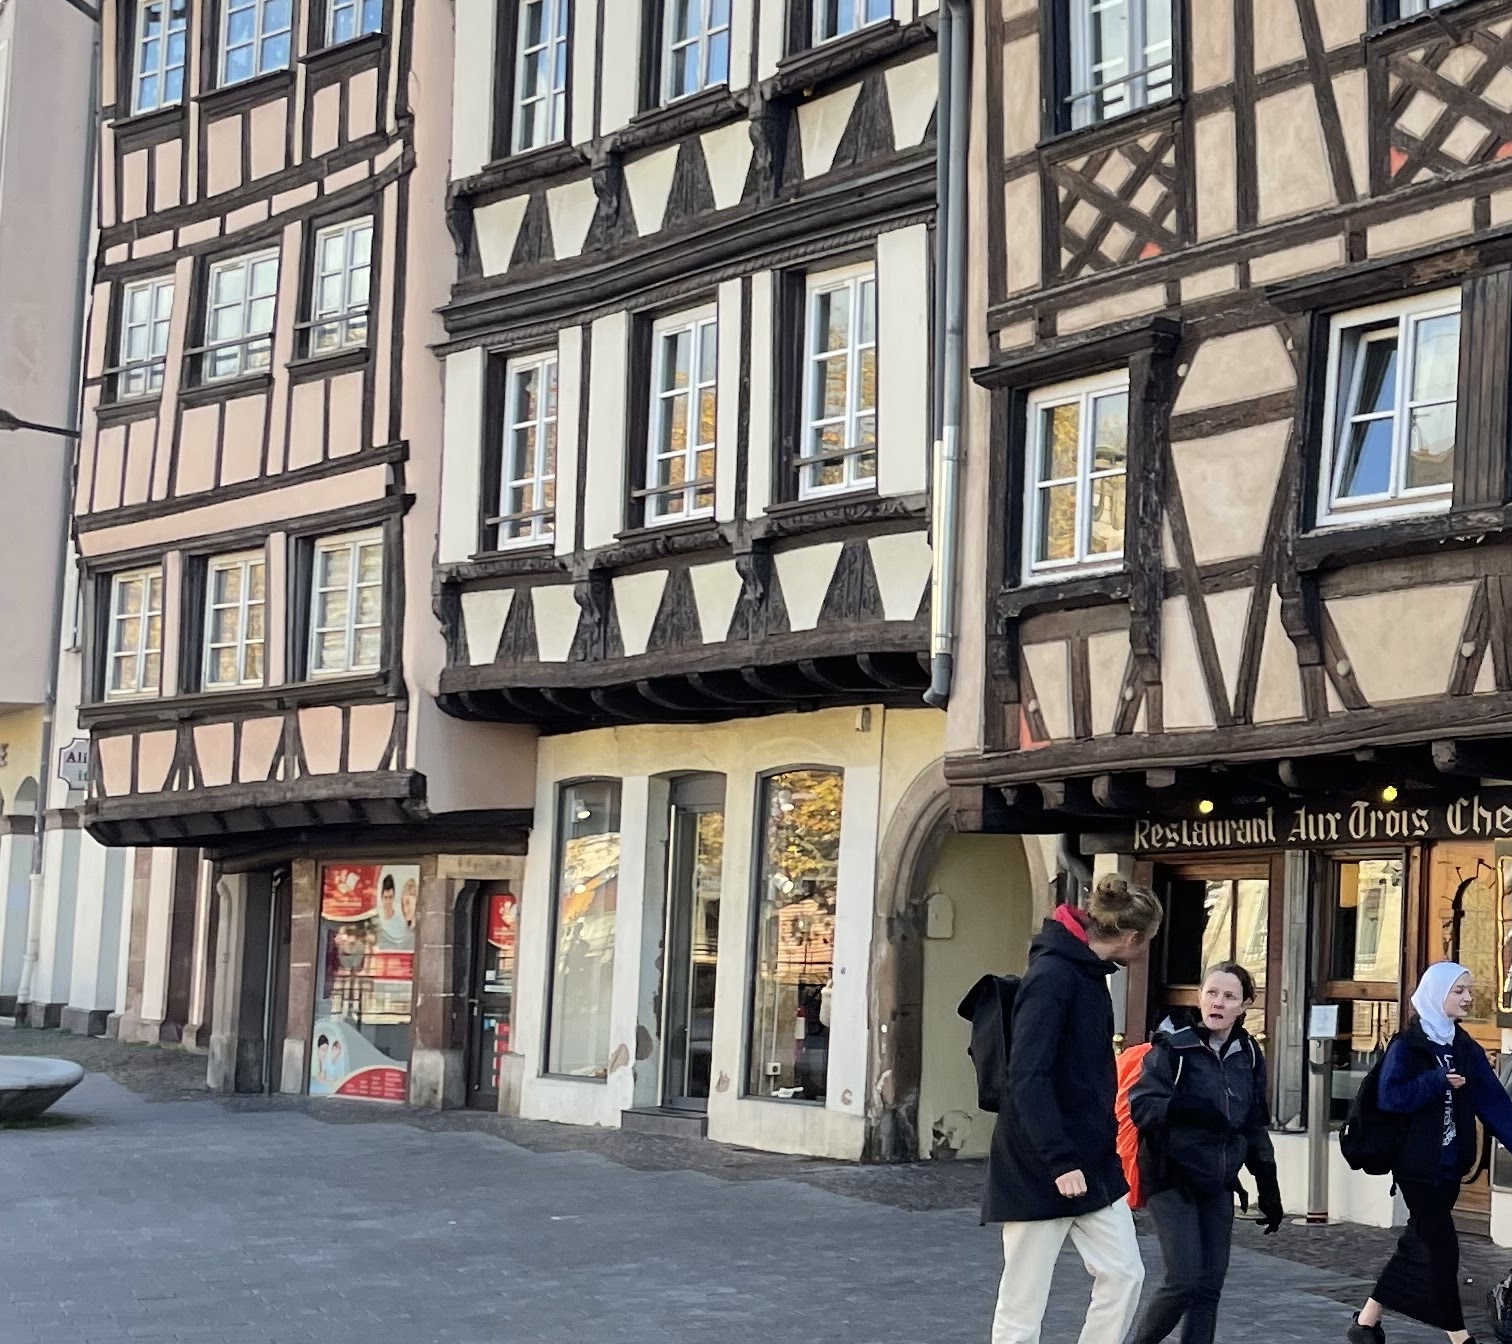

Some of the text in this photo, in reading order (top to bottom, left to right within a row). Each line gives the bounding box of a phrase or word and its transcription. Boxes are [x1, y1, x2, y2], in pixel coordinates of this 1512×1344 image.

[1133, 806, 1277, 850] Restaurant
[1287, 805, 1342, 843] Aux
[1348, 800, 1430, 840] Trois
